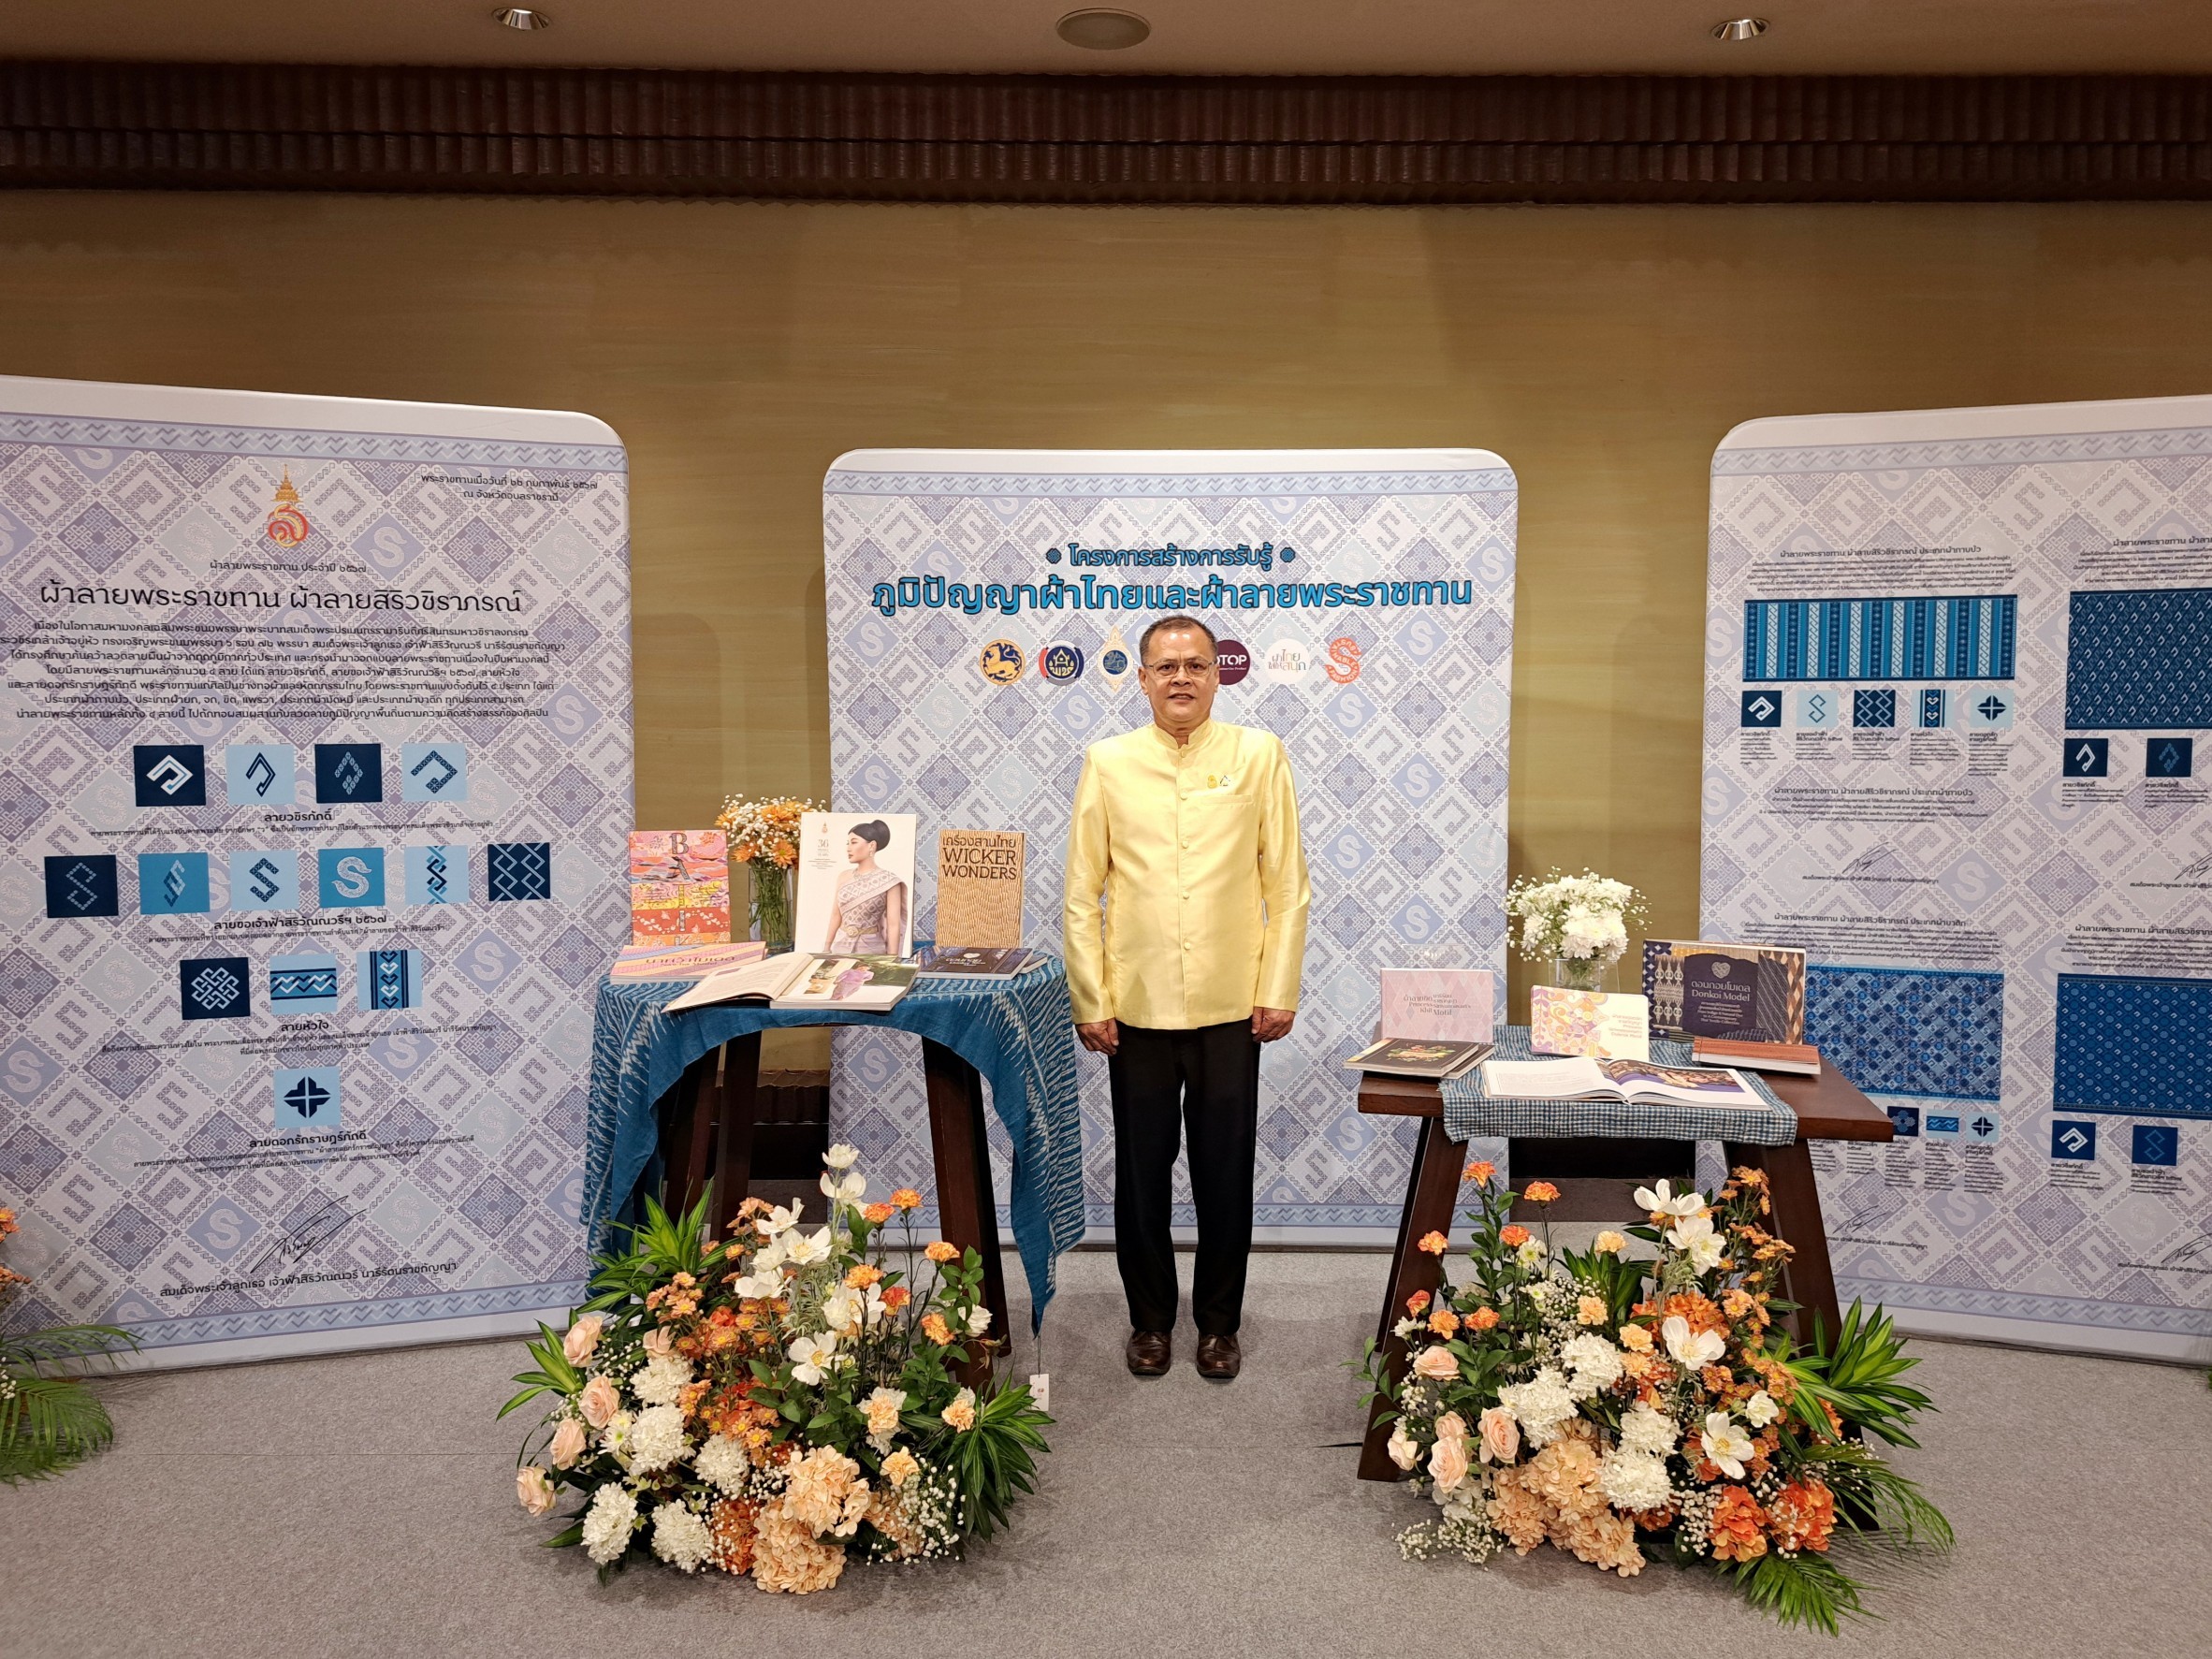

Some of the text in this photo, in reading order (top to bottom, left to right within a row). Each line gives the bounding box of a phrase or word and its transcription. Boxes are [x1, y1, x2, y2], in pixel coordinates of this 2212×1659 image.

[1069, 542, 1273, 572] โครงการสร้างการรับรู้
[210, 560, 298, 572] ผ้าลายพระราชทาน
[41, 578, 521, 612] ผ้าลายพระราชทาน ผ้าลายสิริวชิราภรณ์
[872, 574, 1472, 617] ภูมิปัญญาผ้าไทยและผ้าลายพระราชทาน
[264, 808, 333, 822] ลายวชิรภักดิ์
[941, 834, 1016, 849] เครื่องสานไทย
[941, 847, 1016, 866] WICKER
[941, 864, 1017, 880] WONDERS
[213, 914, 387, 929] ลายขอเจ้าฟ้าสิริวัณณวรีฯ ๒๕๖๗
[1691, 981, 1751, 993] ดอนกอยโมเดล
[1691, 989, 1751, 1002] Donkoi Model
[281, 1019, 329, 1032] ลายหัวใจ
[249, 1129, 367, 1148] ลายดอกรักราษฎร์ภักดี
[159, 1262, 458, 1297] สมเด็จพระเจ้าลูกเธอ เจ้าฟ้าสิริวัณณวรี นารีรัตนราชกัญญา
